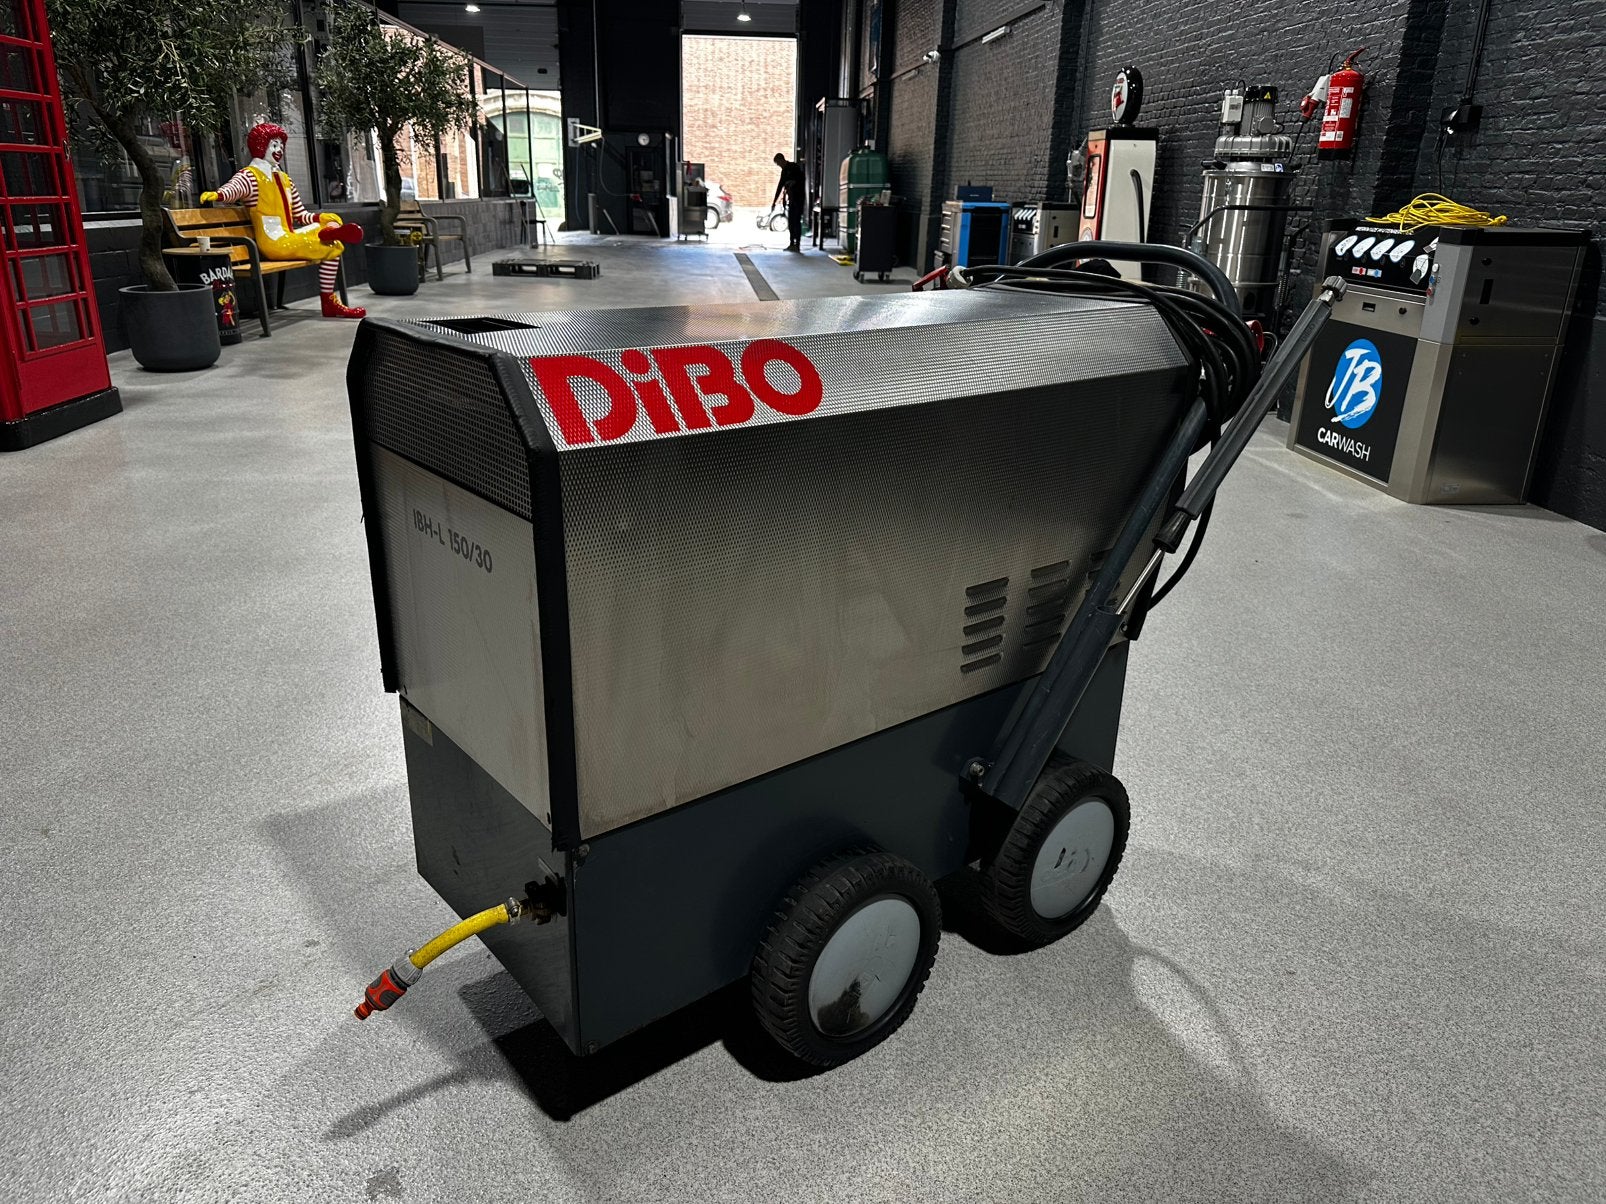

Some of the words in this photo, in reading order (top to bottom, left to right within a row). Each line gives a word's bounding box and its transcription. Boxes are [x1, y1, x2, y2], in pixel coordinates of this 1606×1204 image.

[1324, 348, 1382, 423] JB
[1317, 427, 1371, 461] CARWASH
[413, 509, 445, 546] IBH-L
[447, 528, 493, 573] 150/30
